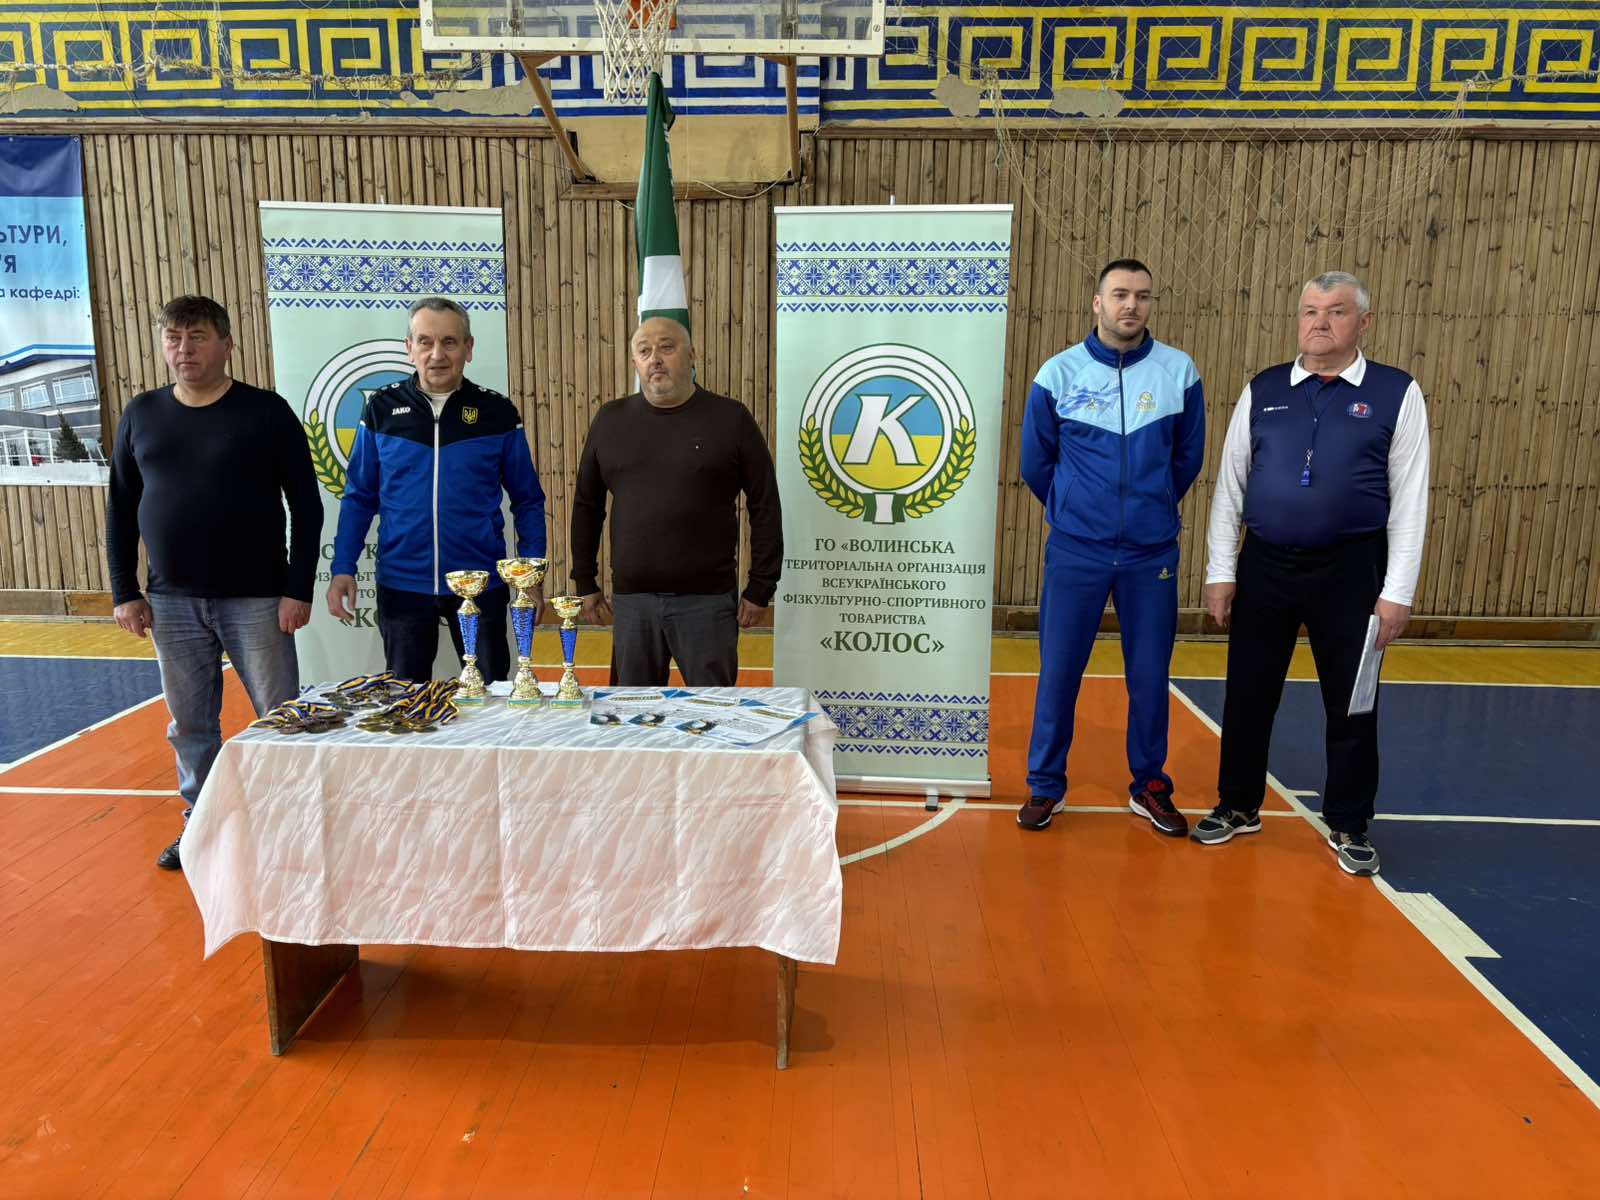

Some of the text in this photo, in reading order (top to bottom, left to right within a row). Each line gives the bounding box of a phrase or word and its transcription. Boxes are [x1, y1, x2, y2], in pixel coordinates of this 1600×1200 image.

[10, 286, 80, 301] кафедрі:
[392, 406, 411, 416] JAKO
[841, 393, 928, 467] К
[815, 538, 955, 554] ГО «ВОЛИНСЬКА
[784, 559, 986, 575] ТЕРИТОРІАЛЬНА ОРГАНІЗАЦІЯ
[822, 577, 946, 591] ВСЕУКРАЇНСЬКОГО
[783, 593, 986, 610] ФІЗКУЛЬТУРНО-СПОРТИВНОГО
[839, 612, 926, 625] ТОВАРИСТВА
[820, 631, 945, 654] «КОЛОС»
